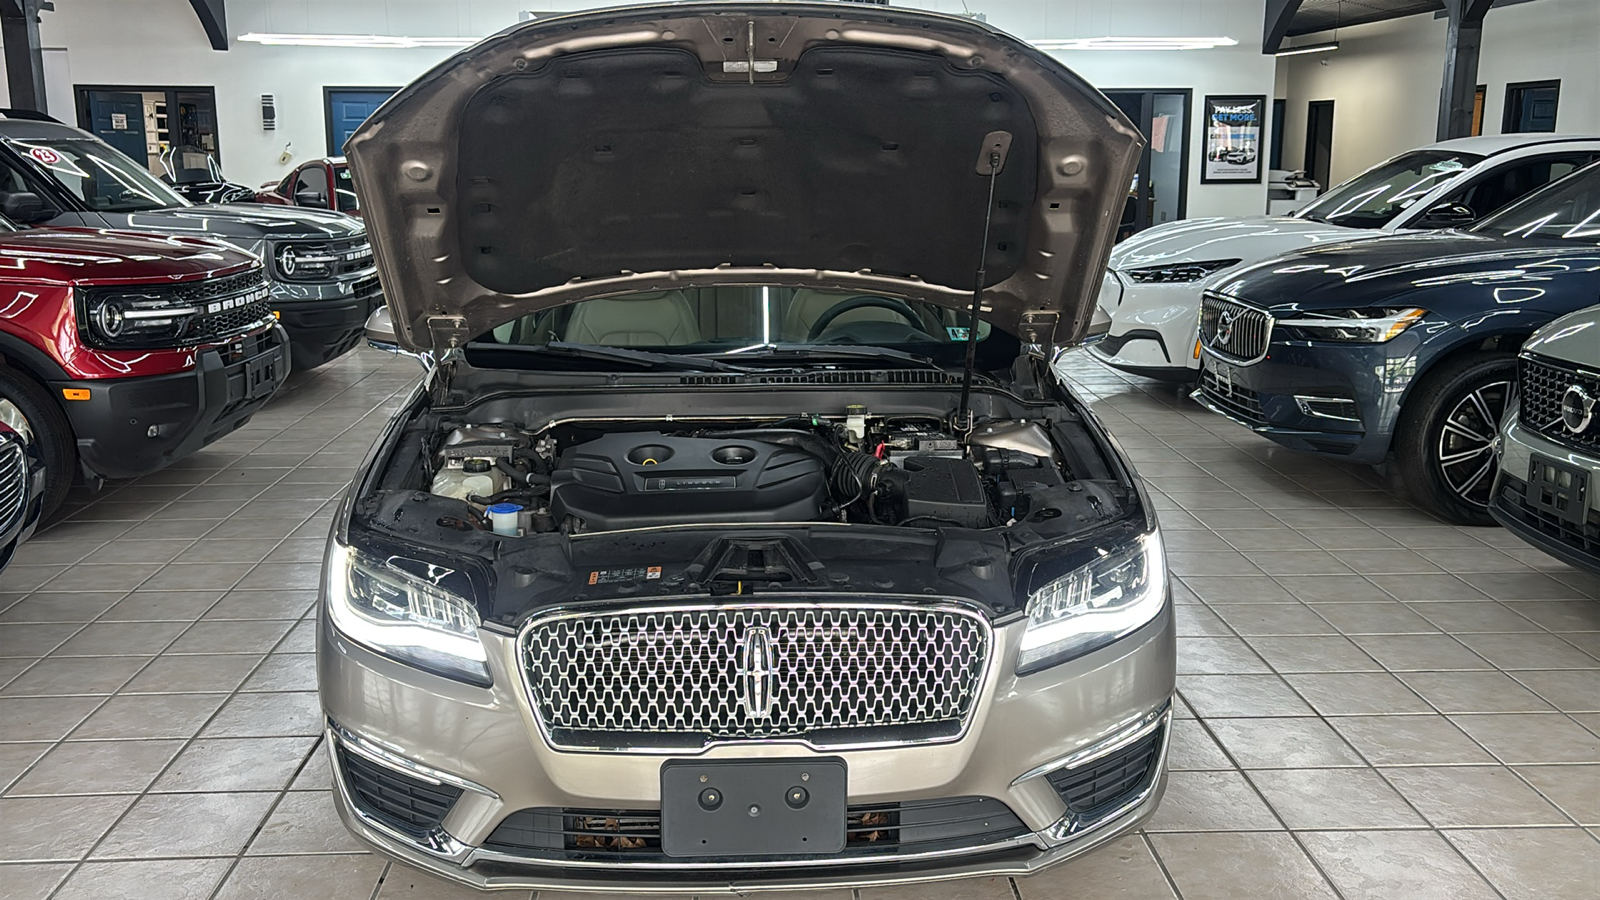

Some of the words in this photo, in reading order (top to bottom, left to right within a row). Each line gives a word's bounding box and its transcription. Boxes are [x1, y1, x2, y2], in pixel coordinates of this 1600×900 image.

[35, 149, 55, 161] 23
[346, 249, 373, 261] BRON
[208, 287, 269, 314] BRONCO
